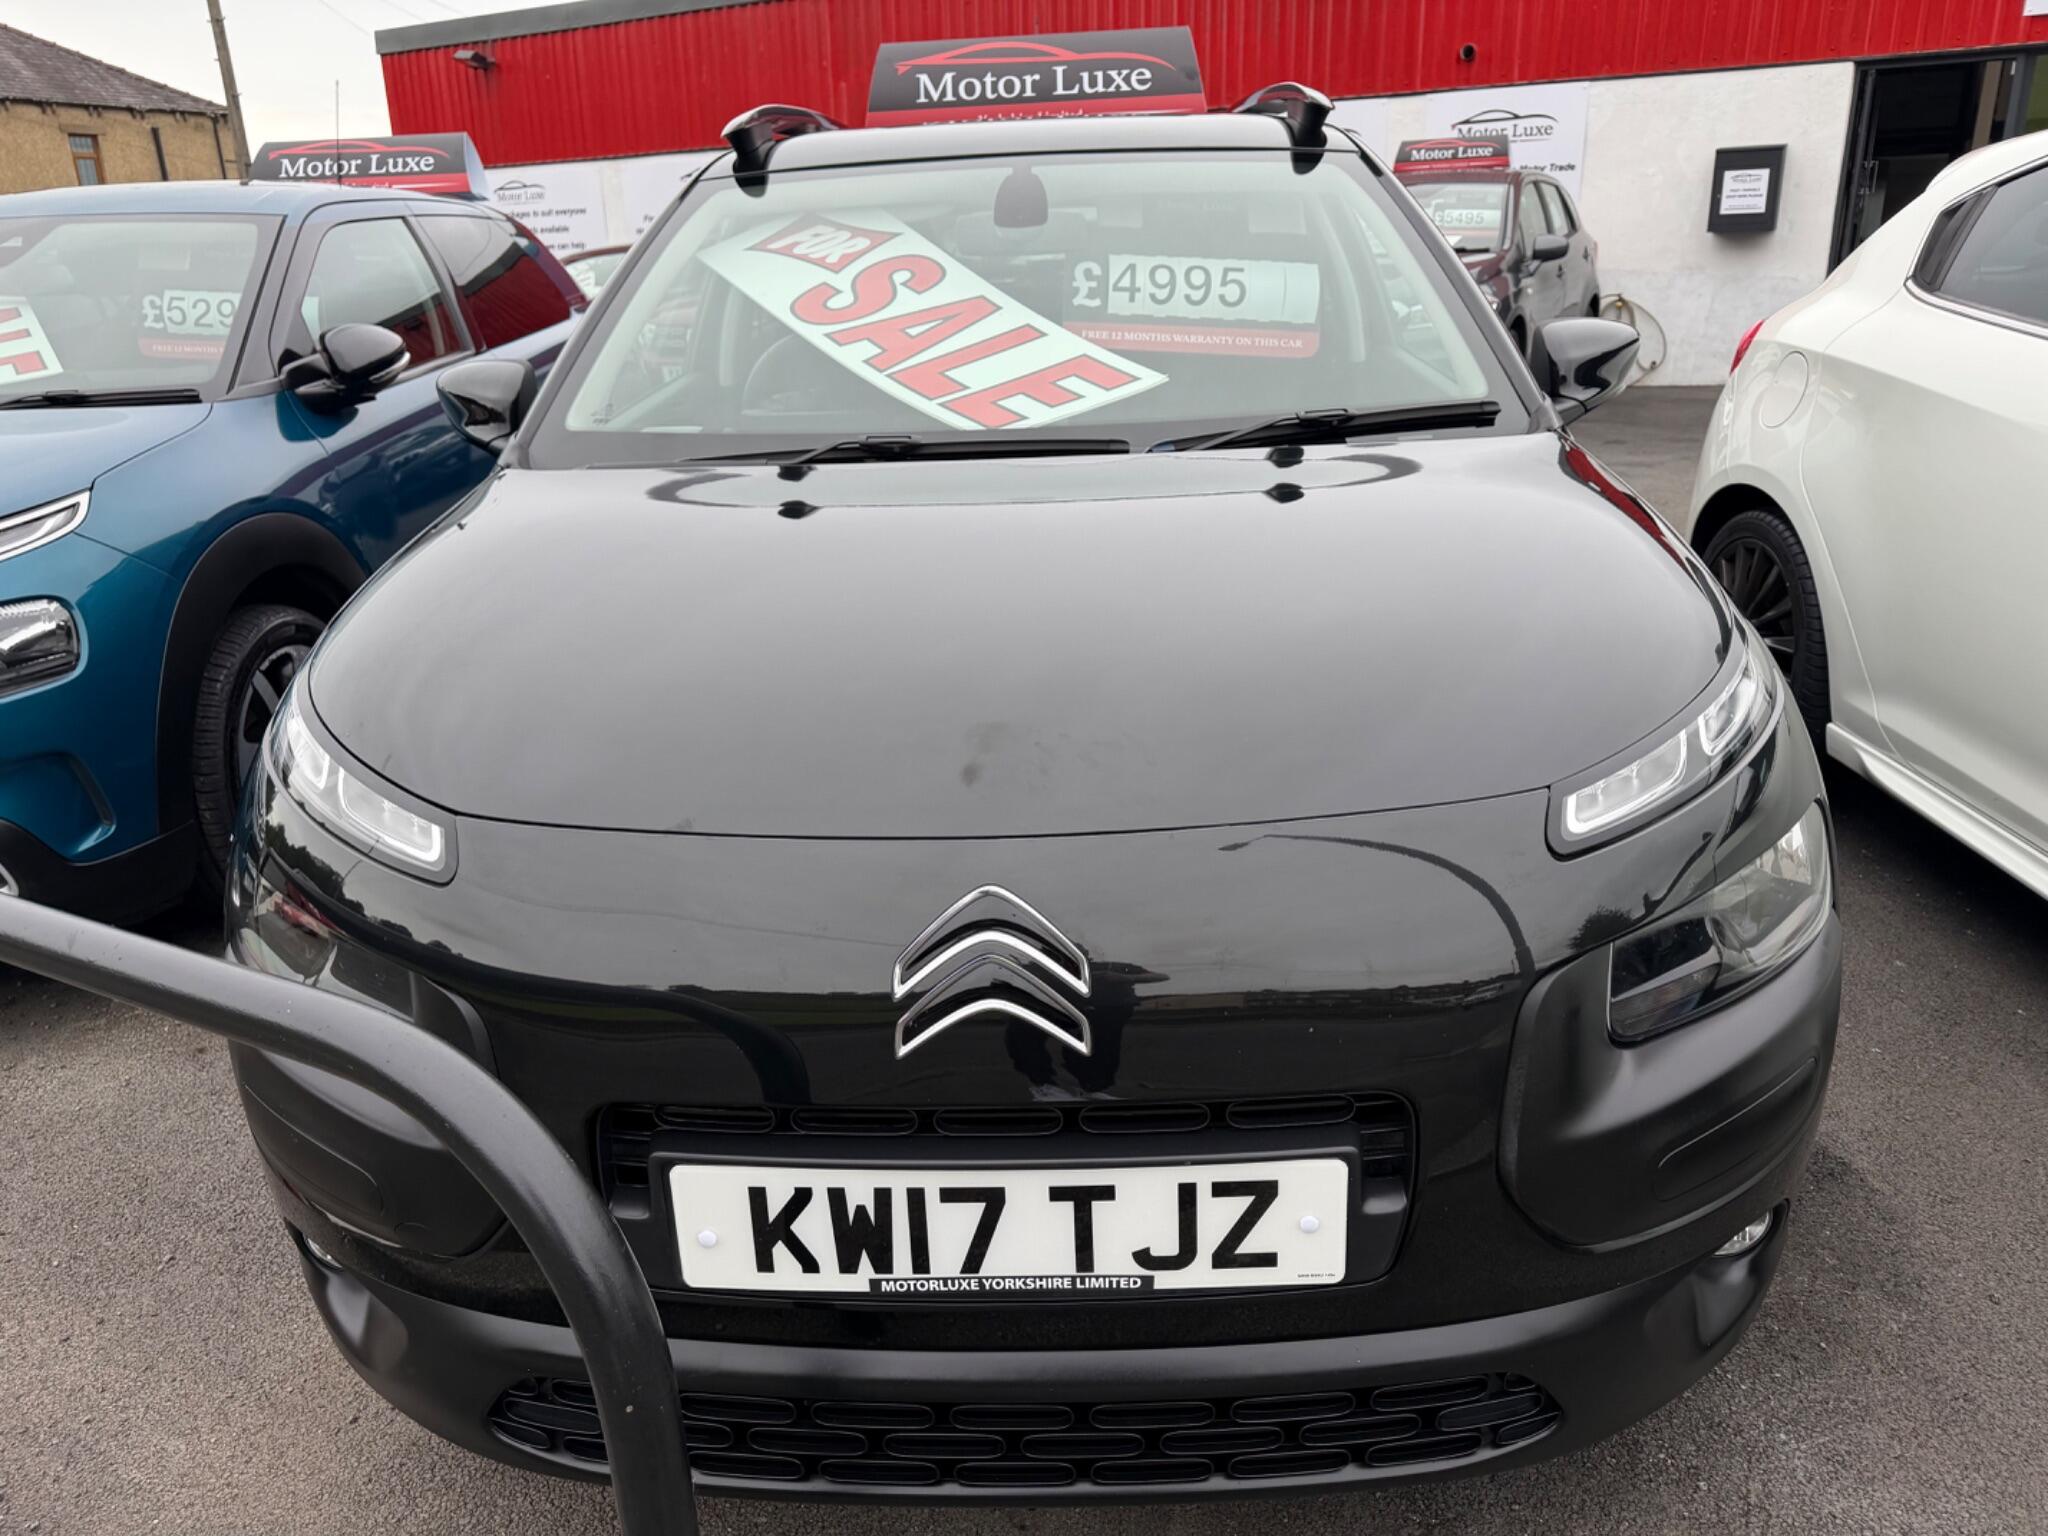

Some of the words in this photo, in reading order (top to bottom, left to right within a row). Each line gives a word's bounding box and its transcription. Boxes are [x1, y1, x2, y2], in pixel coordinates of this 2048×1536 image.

[915, 71, 1040, 103] Motor
[1051, 65, 1152, 96] Luxe
[1511, 123, 1553, 138] Luxe
[279, 156, 362, 178] Motor
[368, 153, 435, 174] Luxe
[1411, 148, 1454, 161] Motor
[1457, 146, 1493, 158] Luxe
[1549, 162, 1576, 172] Trade
[767, 224, 872, 264] FOR
[1072, 260, 1247, 309] £4995
[790, 254, 1142, 428] SALE
[1081, 329, 1110, 340] FREE
[1111, 330, 1123, 341] 12
[1123, 330, 1172, 342] MONTHS
[1172, 332, 1234, 345] WARRANTY
[1235, 335, 1252, 346] ON
[1253, 336, 1279, 347] THIS
[1280, 337, 1303, 348] CAR
[747, 1186, 1007, 1275] KW17
[1049, 1180, 1279, 1273] TJZ
[881, 1278, 980, 1292] MOTORLUXE
[983, 1277, 1073, 1290] YORKSHIRE
[1076, 1276, 1142, 1289] LIMITED
